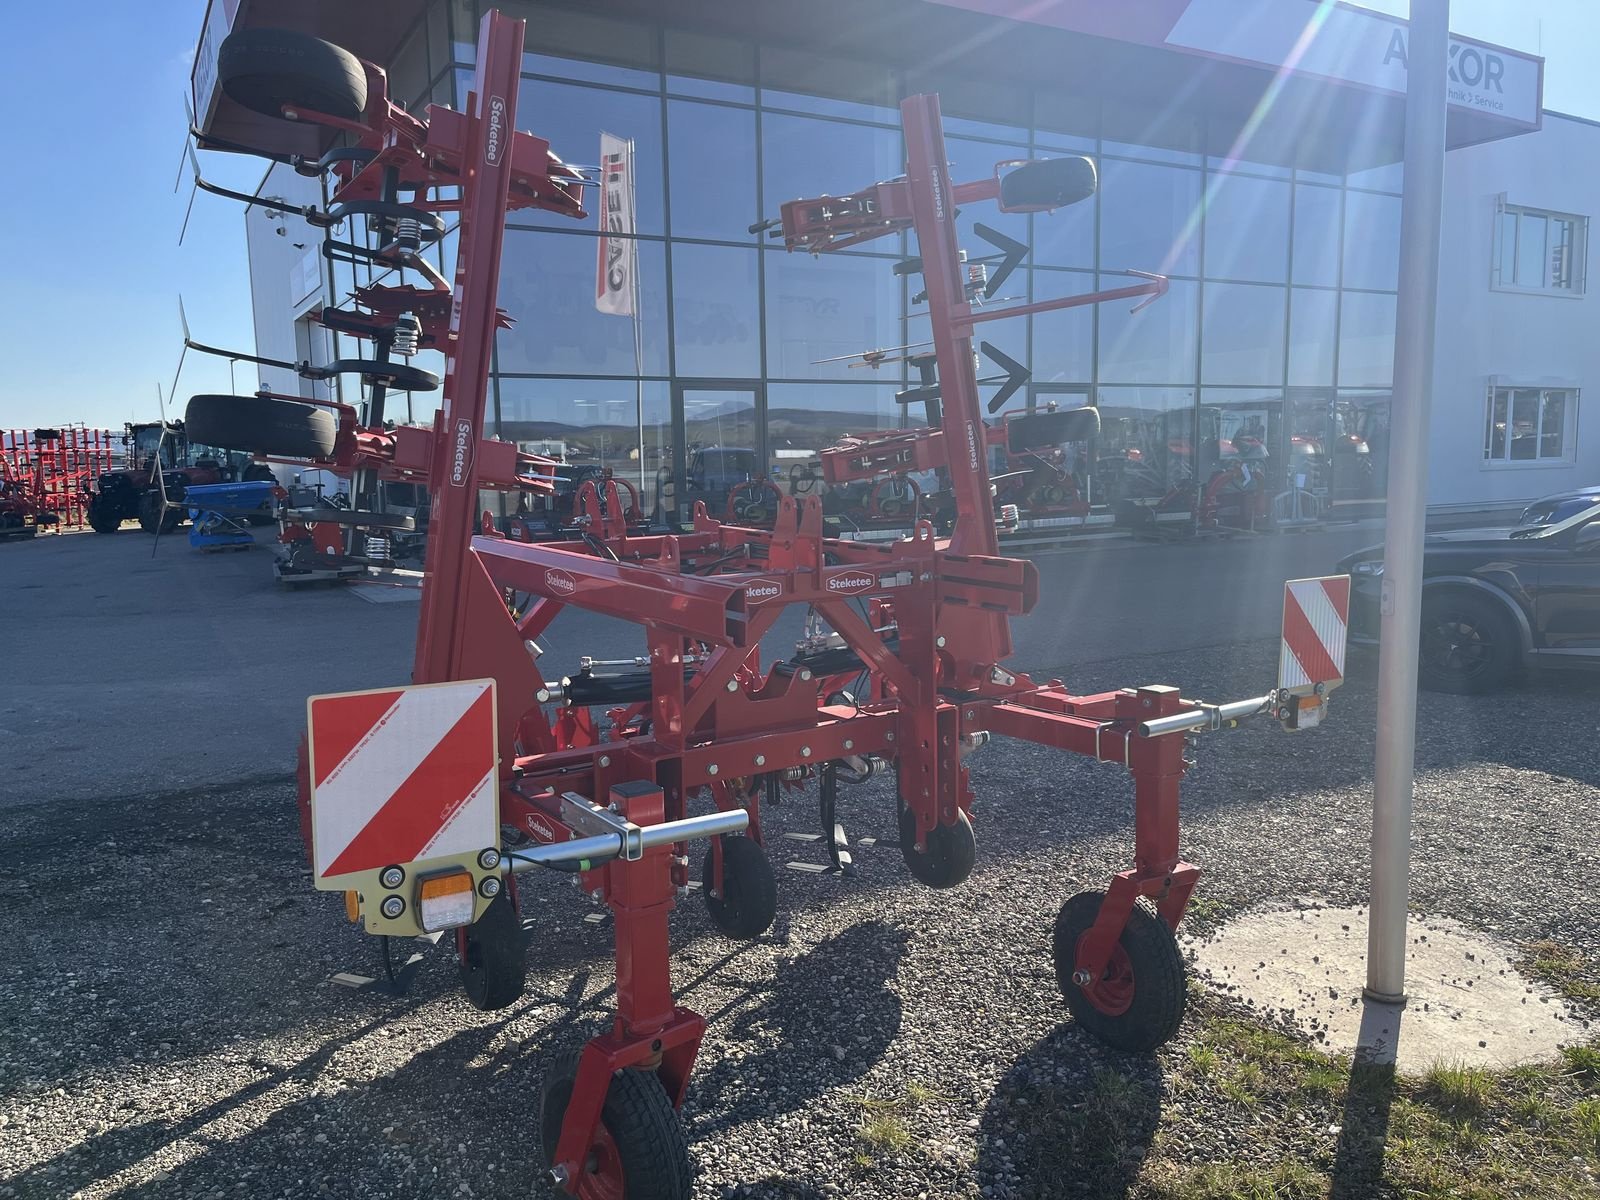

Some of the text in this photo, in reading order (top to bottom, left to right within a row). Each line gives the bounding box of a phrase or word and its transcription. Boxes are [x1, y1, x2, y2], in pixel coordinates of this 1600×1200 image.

[1475, 95, 1504, 110] Service
[487, 101, 503, 161] Steketee
[932, 170, 944, 218] Steketee
[453, 423, 470, 482] Steketee
[967, 424, 978, 469] Steketee
[546, 572, 574, 591] Steketee
[746, 586, 778, 598] ketee
[829, 577, 872, 589] Steketee
[527, 815, 553, 841] Steketee
